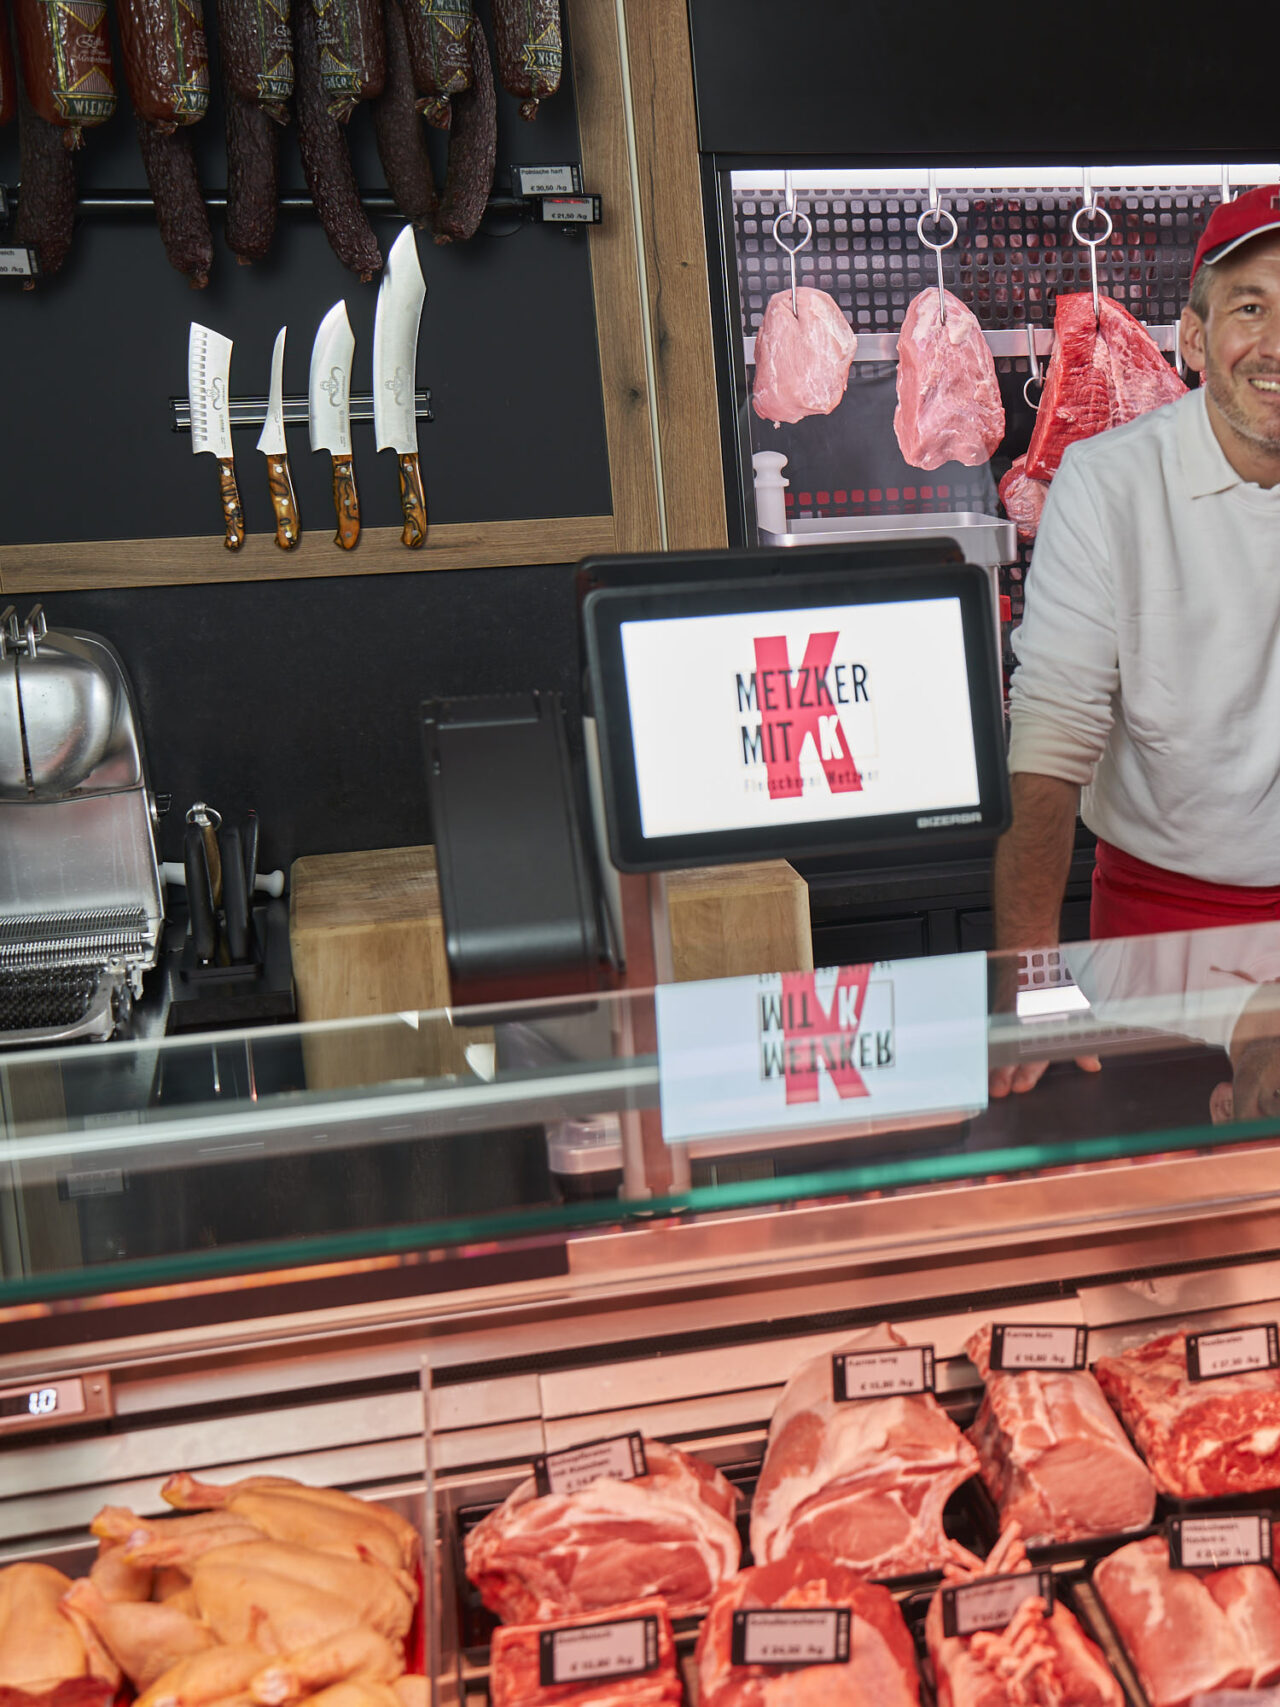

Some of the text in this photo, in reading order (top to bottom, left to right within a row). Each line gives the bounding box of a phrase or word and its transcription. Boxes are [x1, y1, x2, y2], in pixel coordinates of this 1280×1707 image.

[736, 664, 869, 713] METZKER
[741, 714, 844, 765] MIT K
